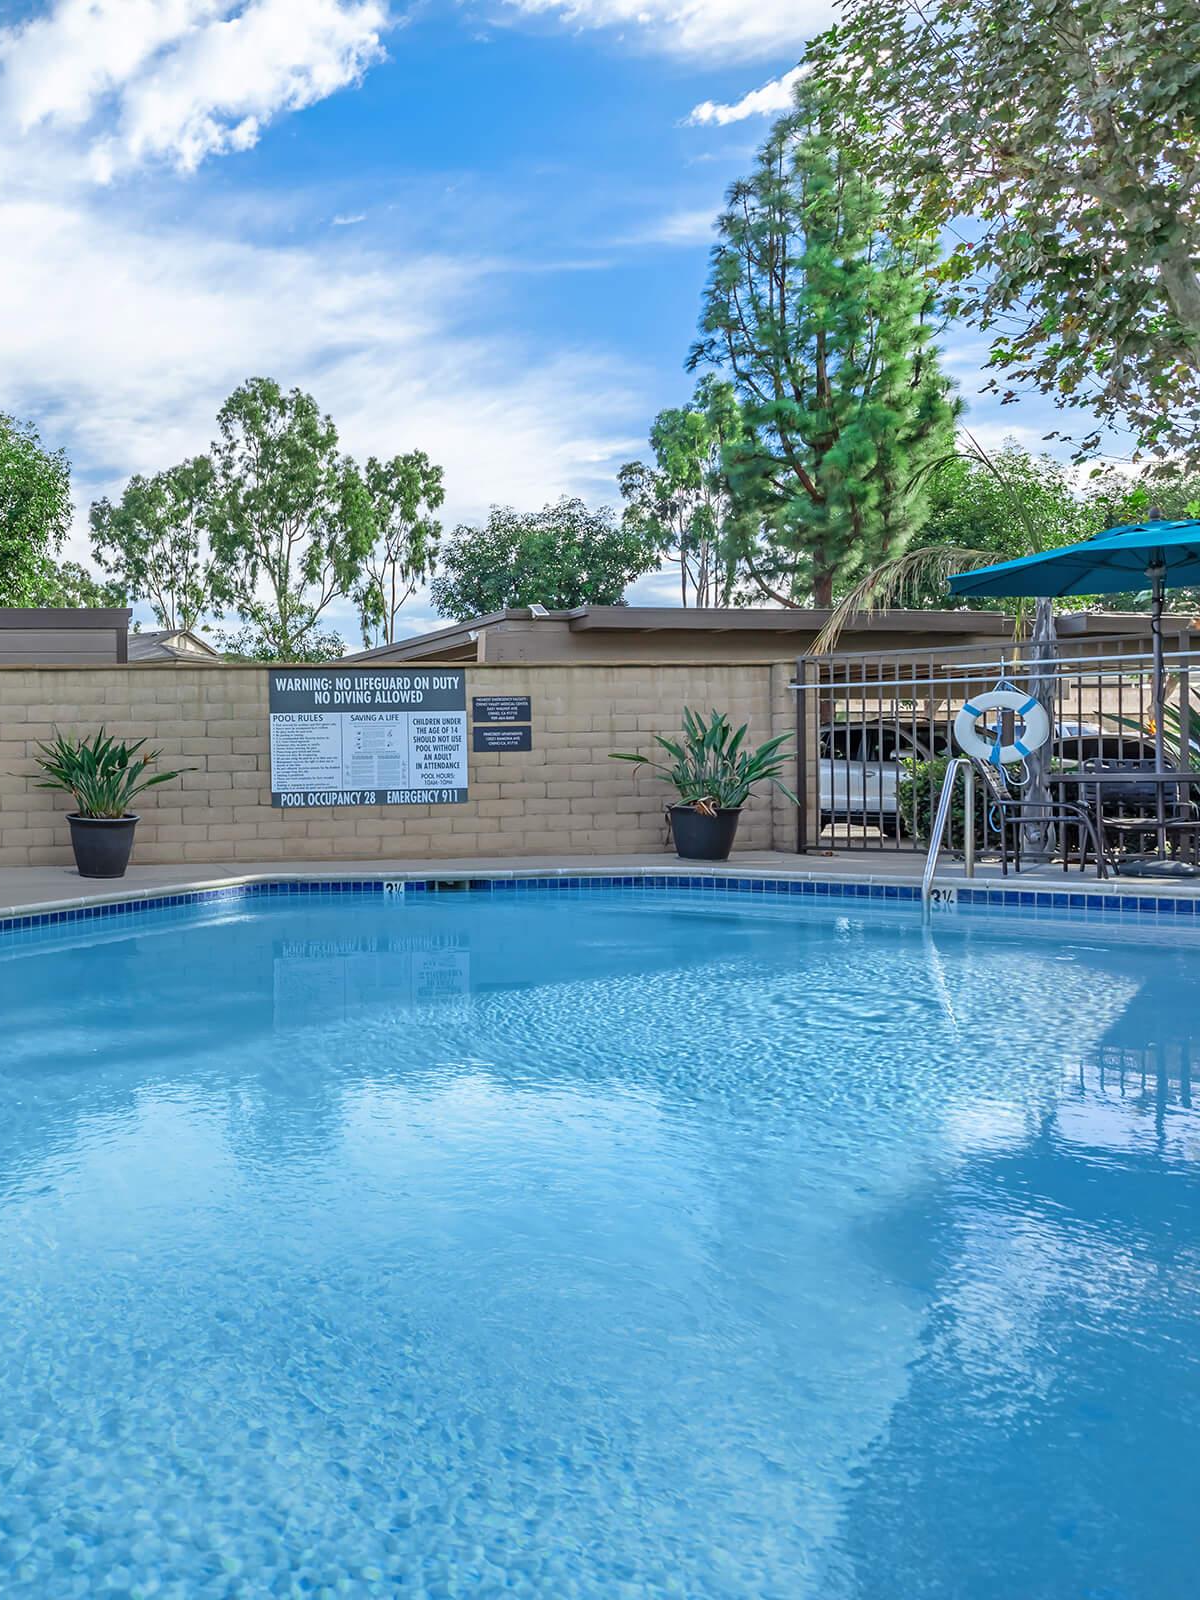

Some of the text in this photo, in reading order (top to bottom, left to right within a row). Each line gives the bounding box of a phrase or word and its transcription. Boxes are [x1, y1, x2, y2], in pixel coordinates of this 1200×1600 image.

[275, 677, 459, 691] WARNING: NO LIFEGUARD ON DUTY
[314, 691, 423, 704] NO DIVING ALLOWED
[281, 791, 376, 806] POOL OCCUPANCY 28
[387, 790, 458, 804] EMERGENCY 911
